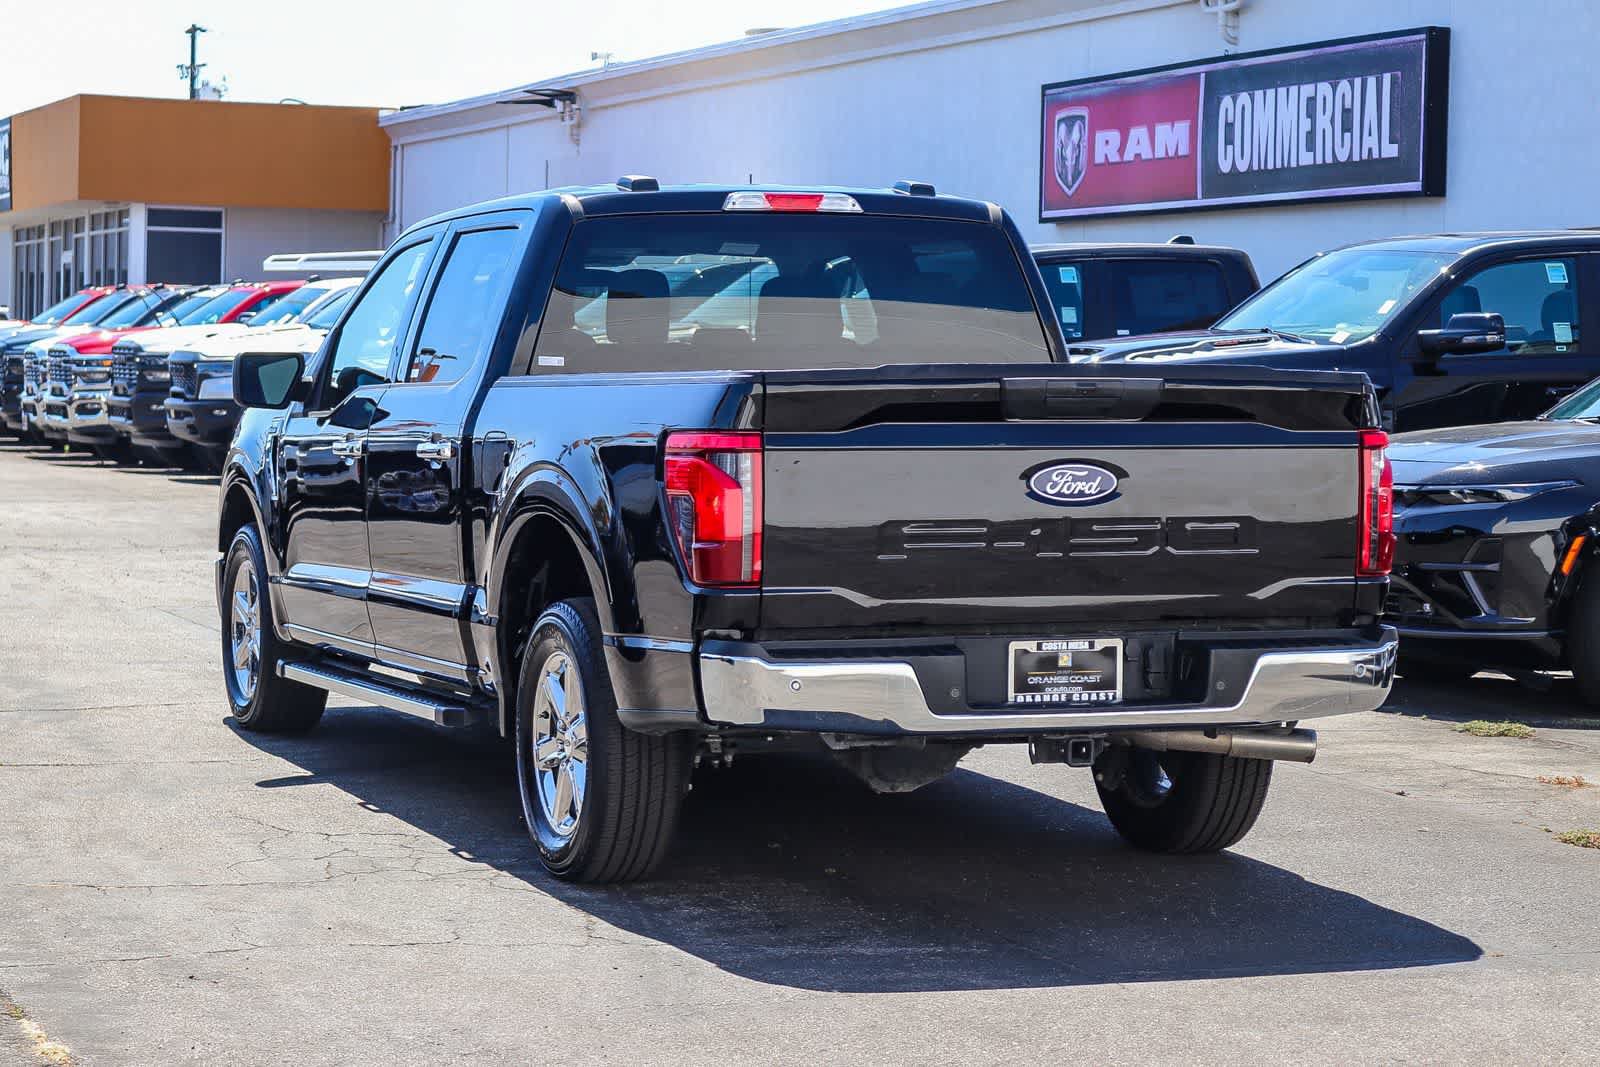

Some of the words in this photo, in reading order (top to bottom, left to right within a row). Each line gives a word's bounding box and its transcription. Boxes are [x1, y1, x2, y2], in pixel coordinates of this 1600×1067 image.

[1216, 72, 1400, 174] COMMERCIAL
[1094, 119, 1192, 165] RAM
[1046, 468, 1104, 496] Ford
[1041, 642, 1067, 650] COSTA
[1027, 676, 1069, 685] ORANGE
[1069, 675, 1102, 683] COAST
[1072, 692, 1115, 701] COAST
